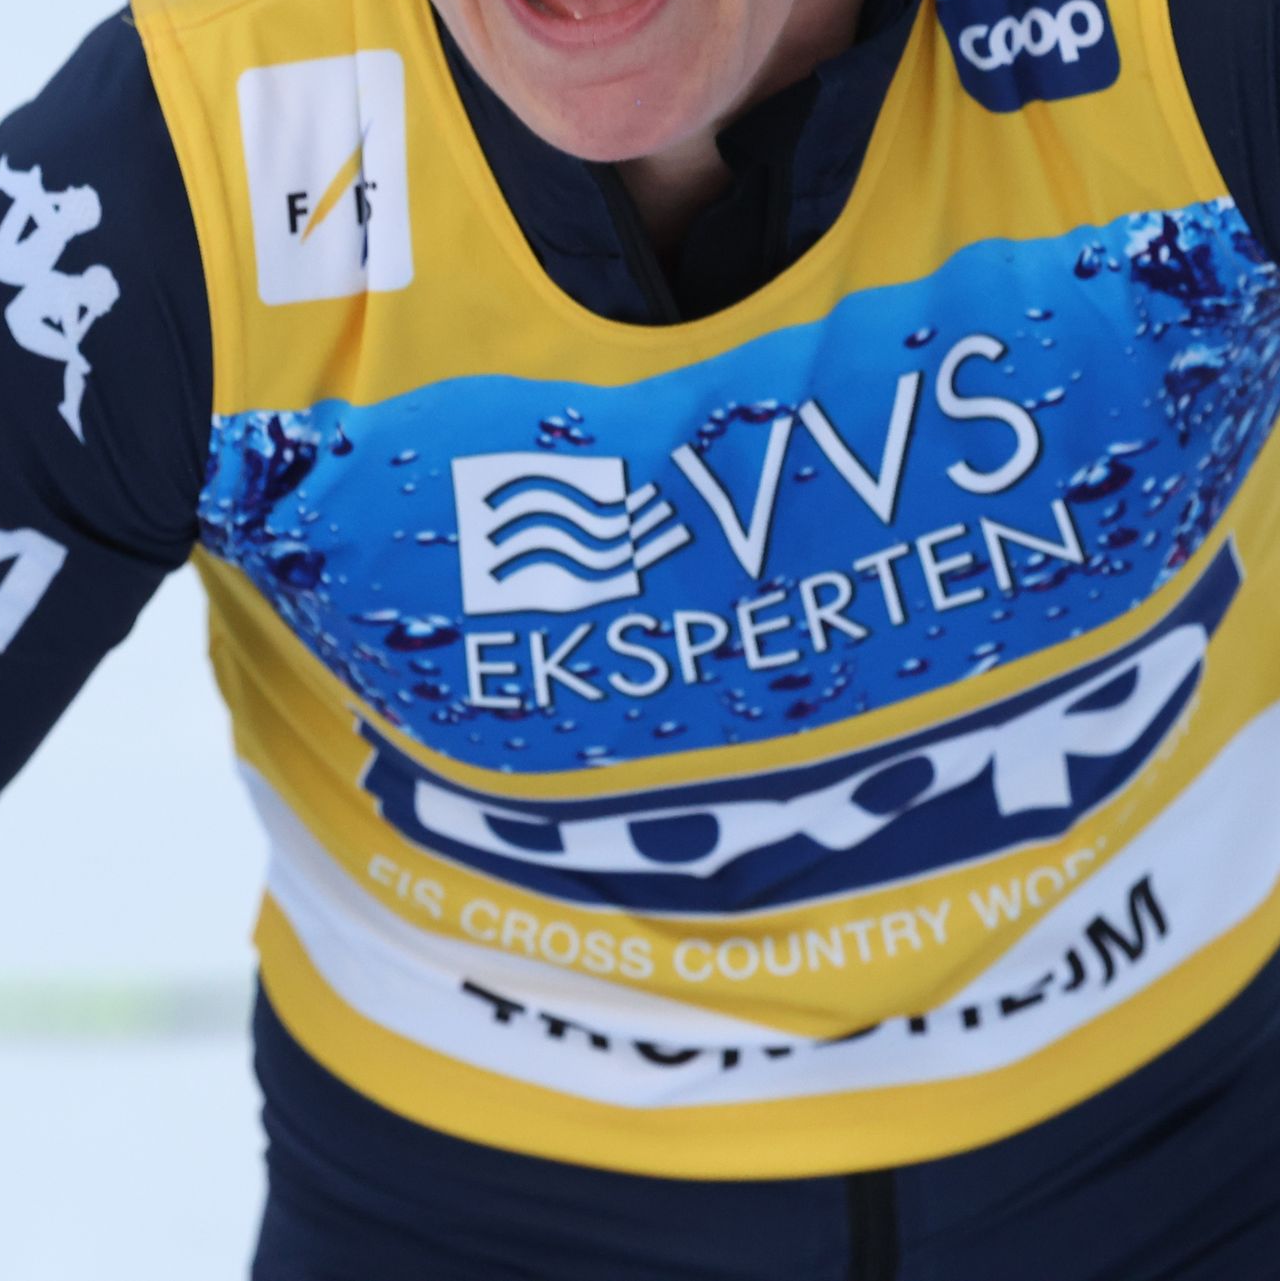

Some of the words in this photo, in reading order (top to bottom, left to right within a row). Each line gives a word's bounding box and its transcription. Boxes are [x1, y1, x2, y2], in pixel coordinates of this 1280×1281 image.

[671, 334, 1040, 580] VVS
[463, 499, 1086, 710] EKSPERTEN
[460, 898, 654, 980] CROSS
[672, 898, 951, 983] COUNTRY
